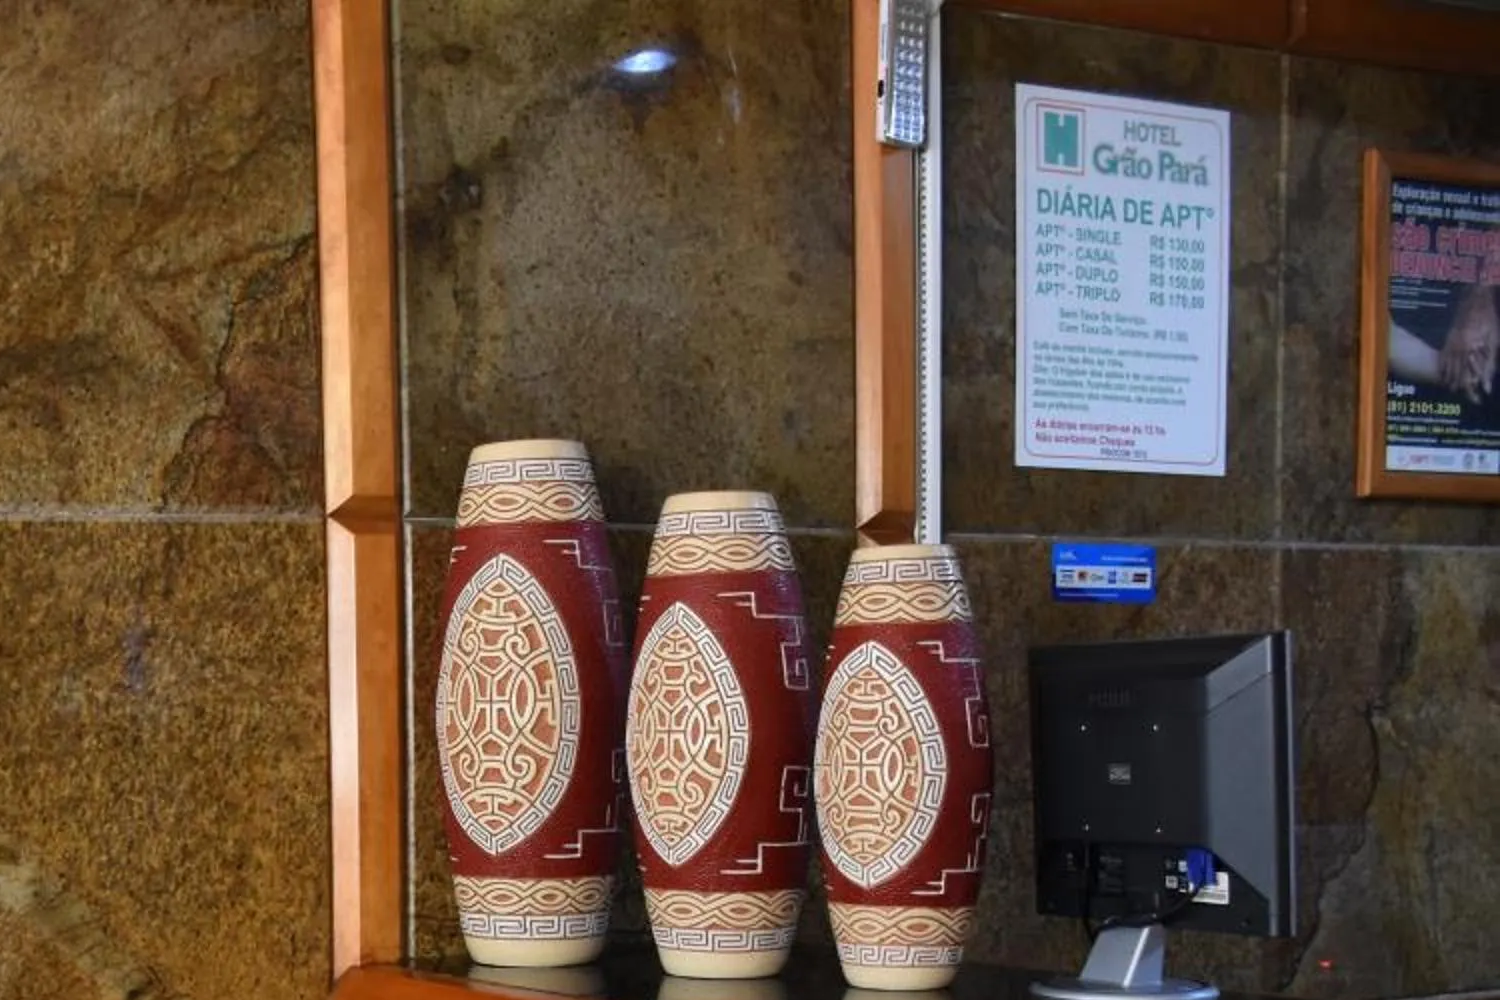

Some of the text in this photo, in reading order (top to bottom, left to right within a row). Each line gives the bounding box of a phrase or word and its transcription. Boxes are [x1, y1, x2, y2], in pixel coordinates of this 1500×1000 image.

[1123, 120, 1182, 147] HOTEL
[1092, 143, 1209, 187] Grão Pará
[1036, 185, 1117, 222] DIÁRIA
[1123, 199, 1154, 226] DE
[1075, 228, 1122, 245] SINGLE
[1150, 235, 1165, 250] R$
[1075, 247, 1118, 265] CASAL
[1150, 254, 1165, 269] R$
[1075, 265, 1119, 284] DUPLO
[1150, 273, 1165, 289] R$
[1075, 285, 1121, 303] TRIPLO
[1150, 292, 1165, 307] R$
